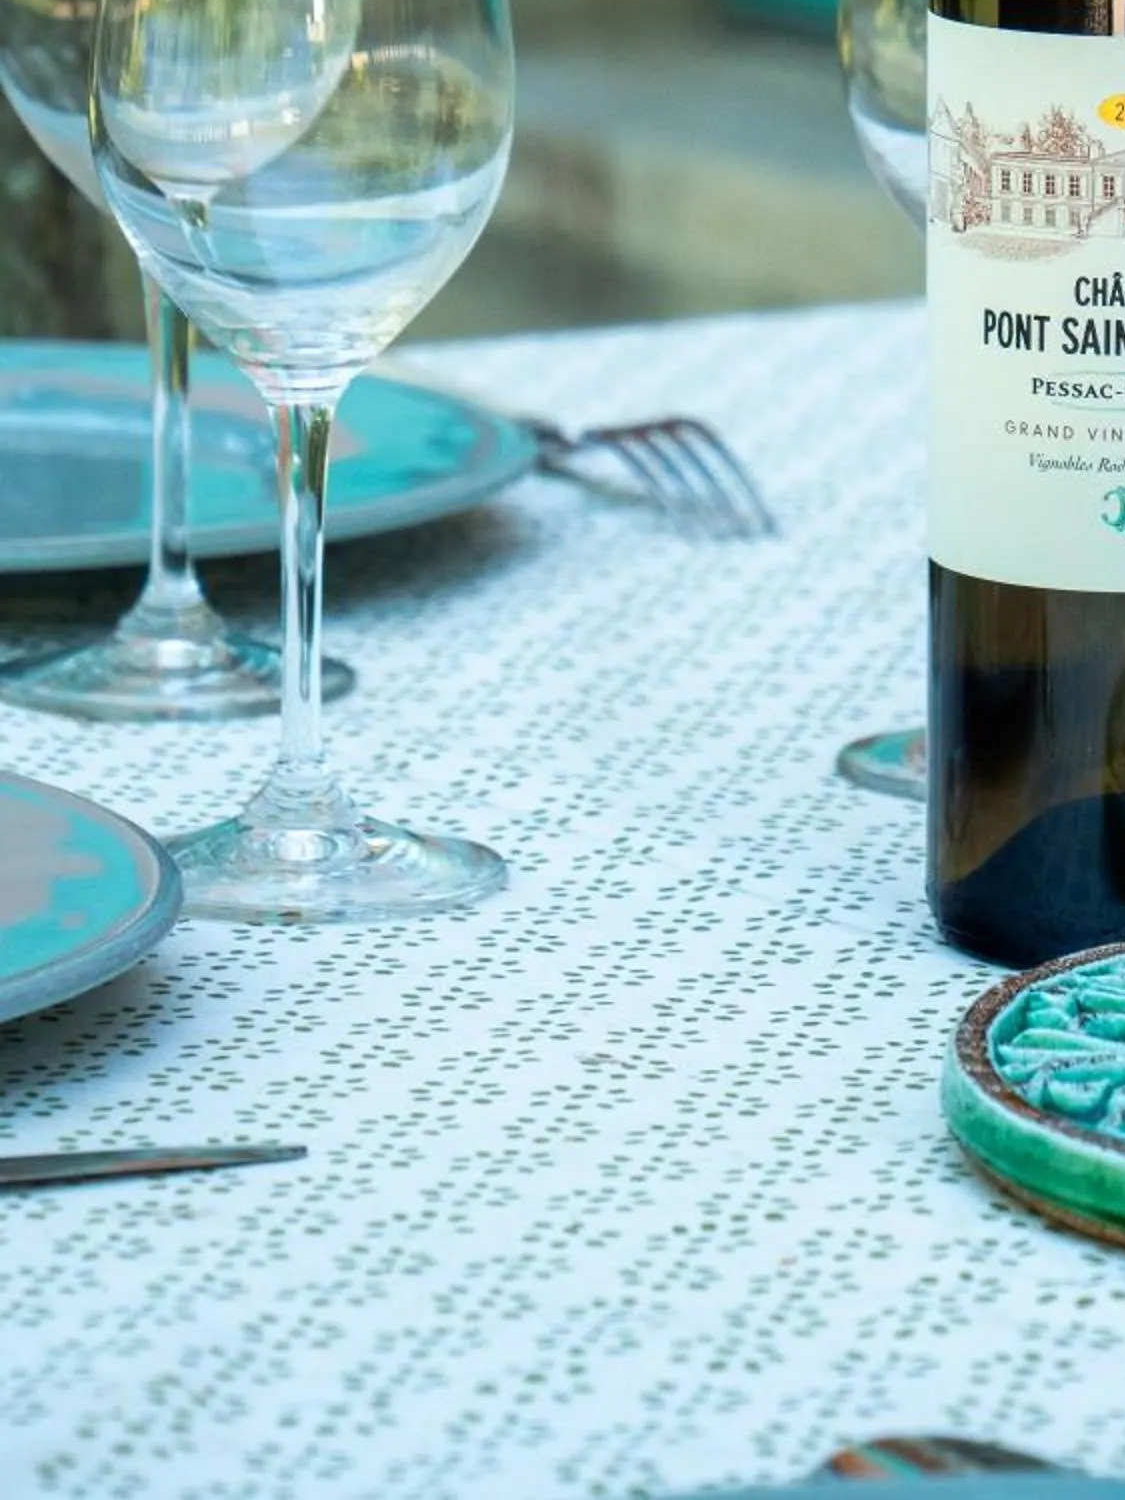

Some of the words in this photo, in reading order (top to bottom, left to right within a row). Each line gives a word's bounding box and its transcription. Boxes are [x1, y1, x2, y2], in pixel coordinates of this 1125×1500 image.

[983, 308, 1050, 352] PONT
[1004, 419, 1075, 440] GRAND
[1087, 428, 1124, 442] VIN
[1028, 453, 1093, 472] Vignobles
